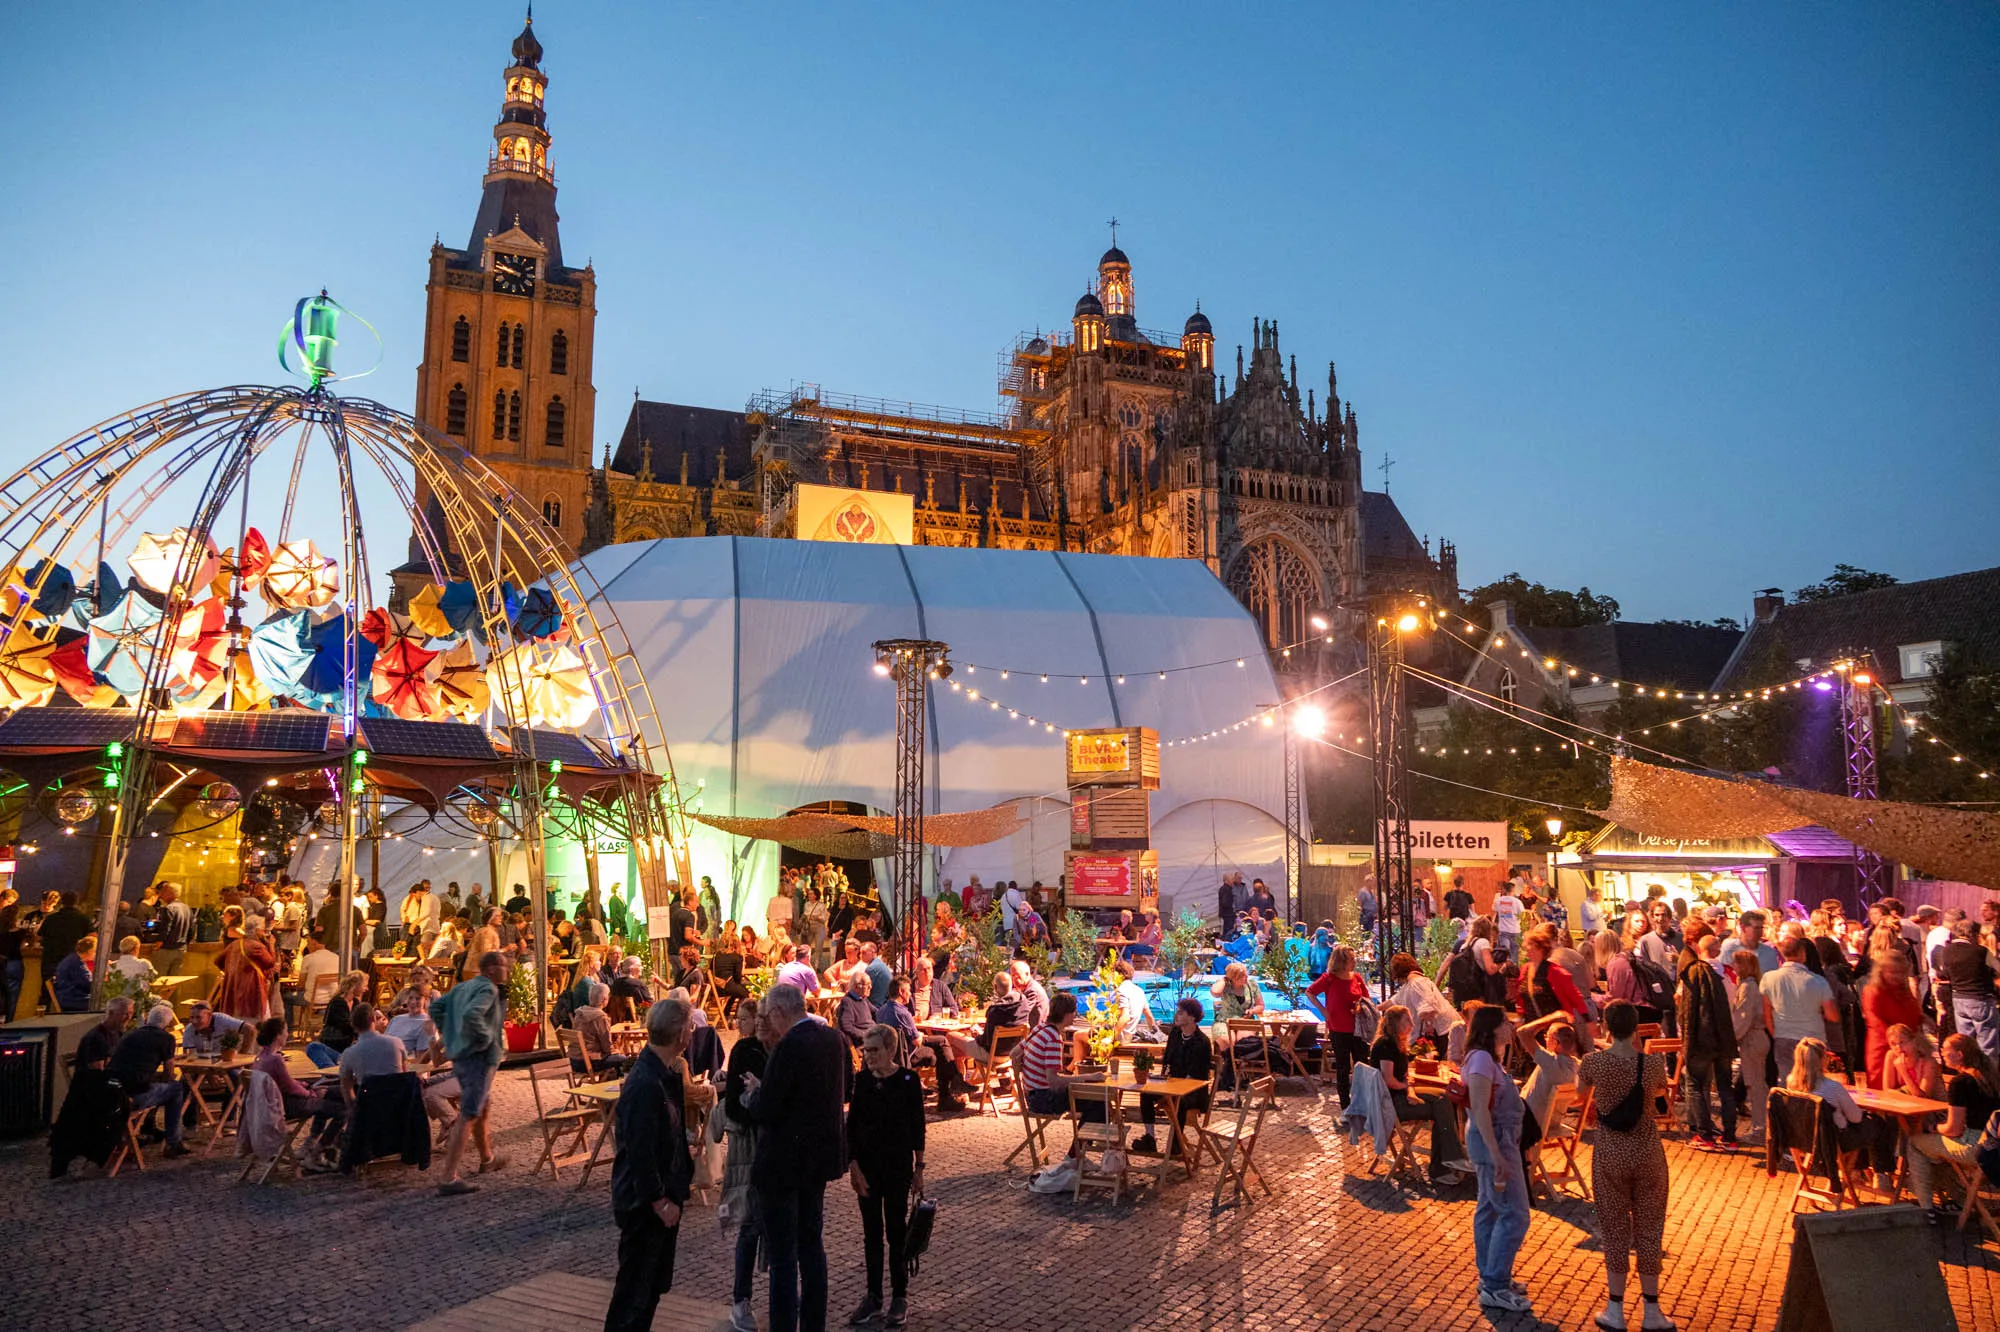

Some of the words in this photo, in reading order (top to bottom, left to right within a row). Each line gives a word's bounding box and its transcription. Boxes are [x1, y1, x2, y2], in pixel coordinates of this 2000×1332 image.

[1080, 743, 1122, 754] BLVRD
[1077, 754, 1126, 765] Theater
[1393, 831, 1490, 849] oiletten
